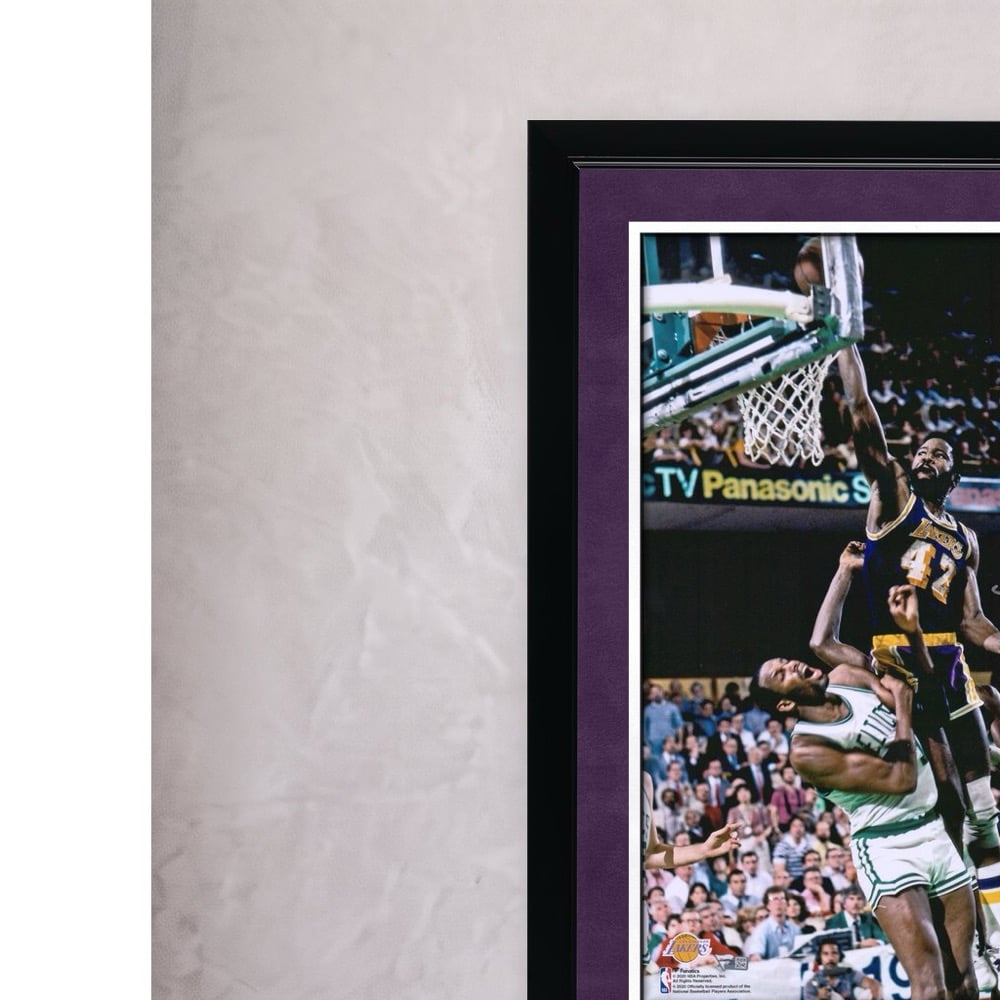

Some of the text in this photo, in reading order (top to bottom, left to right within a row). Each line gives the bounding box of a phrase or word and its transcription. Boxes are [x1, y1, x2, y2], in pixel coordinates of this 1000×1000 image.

[655, 466, 698, 498] TV
[702, 469, 849, 501] Panasonic
[900, 540, 958, 605] 42
